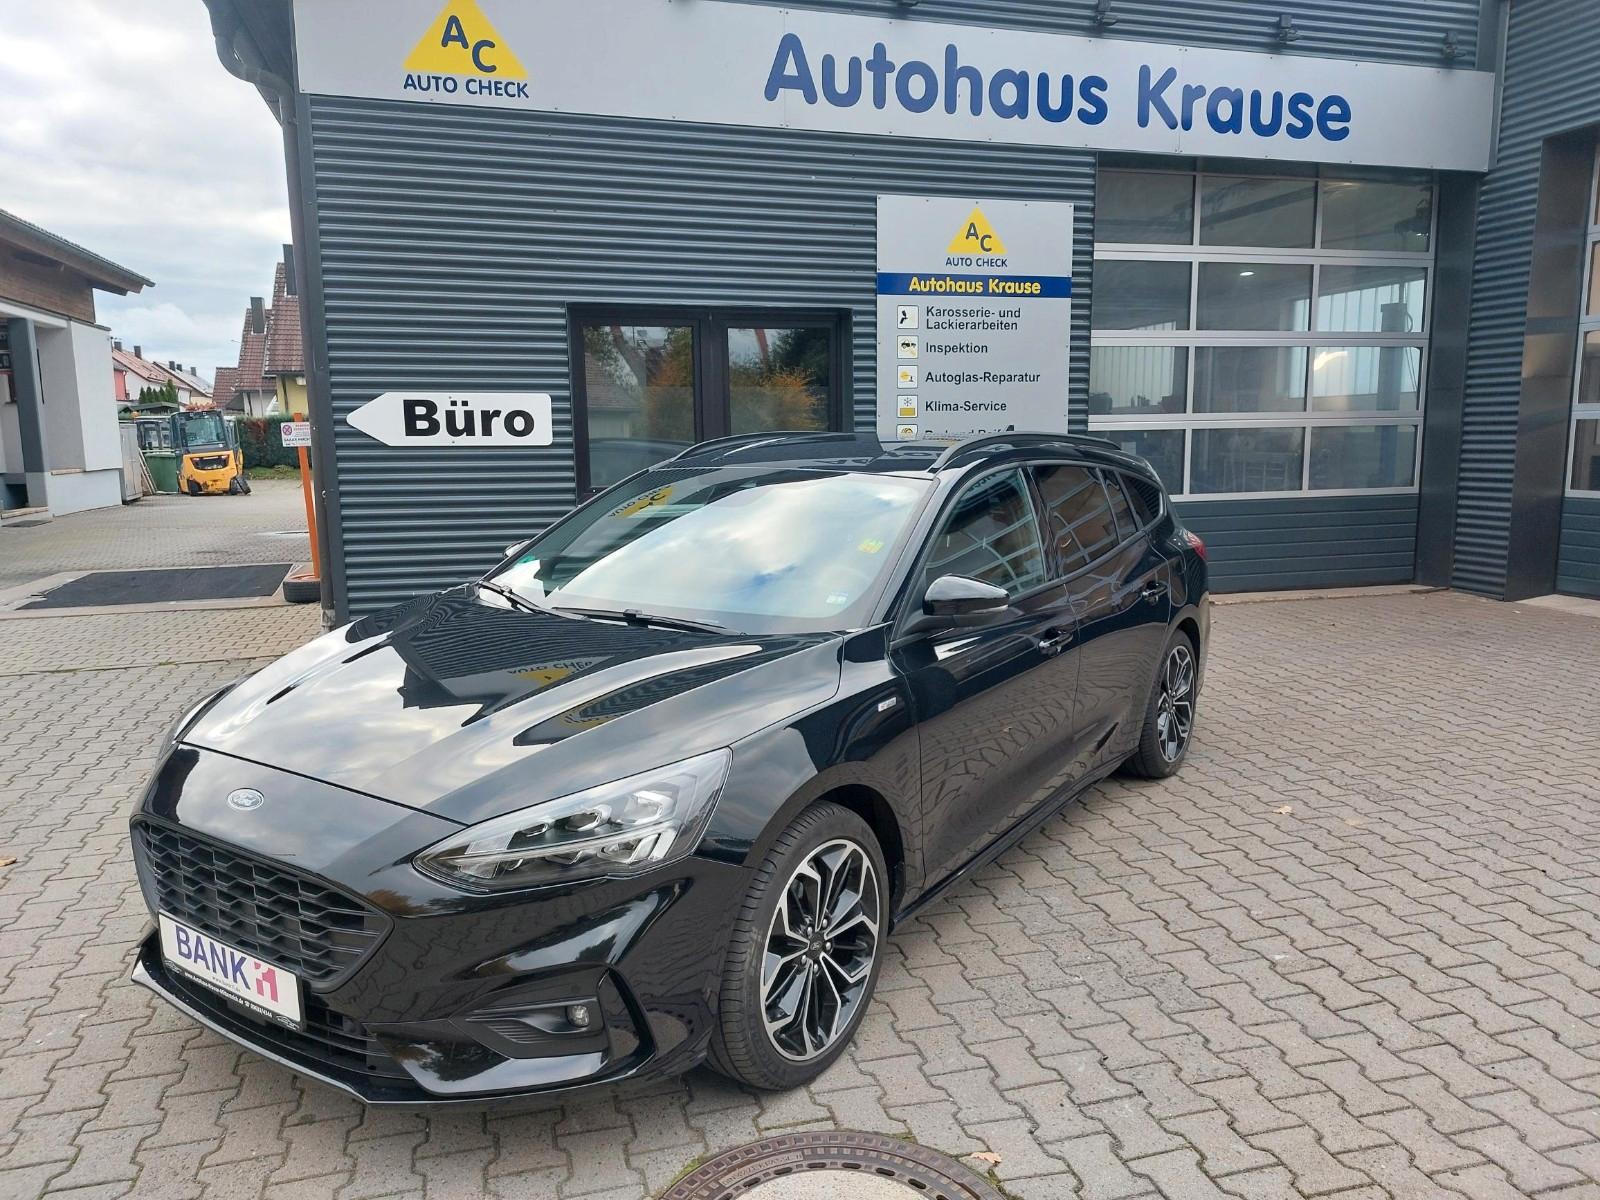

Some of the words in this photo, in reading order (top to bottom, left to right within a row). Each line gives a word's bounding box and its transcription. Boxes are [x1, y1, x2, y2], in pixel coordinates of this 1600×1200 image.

[403, 73, 458, 94] AUTO
[465, 78, 530, 99] CHECK
[764, 32, 1108, 126] Autohaus
[1137, 64, 1352, 141] Krause
[945, 257, 973, 267] AUTO
[975, 257, 1008, 268] CHECK
[908, 276, 984, 293] Autohaus
[988, 279, 1041, 294] Krause
[926, 306, 996, 318] Karosserie-
[998, 307, 1021, 318] und
[926, 319, 1018, 331] Lackierarbeiten
[926, 342, 988, 355] Inspektion
[925, 371, 1040, 385] Autoglas-Reparatur
[925, 401, 1007, 412] Klima-Service
[402, 399, 535, 437] Büro
[175, 924, 251, 990] BANK
